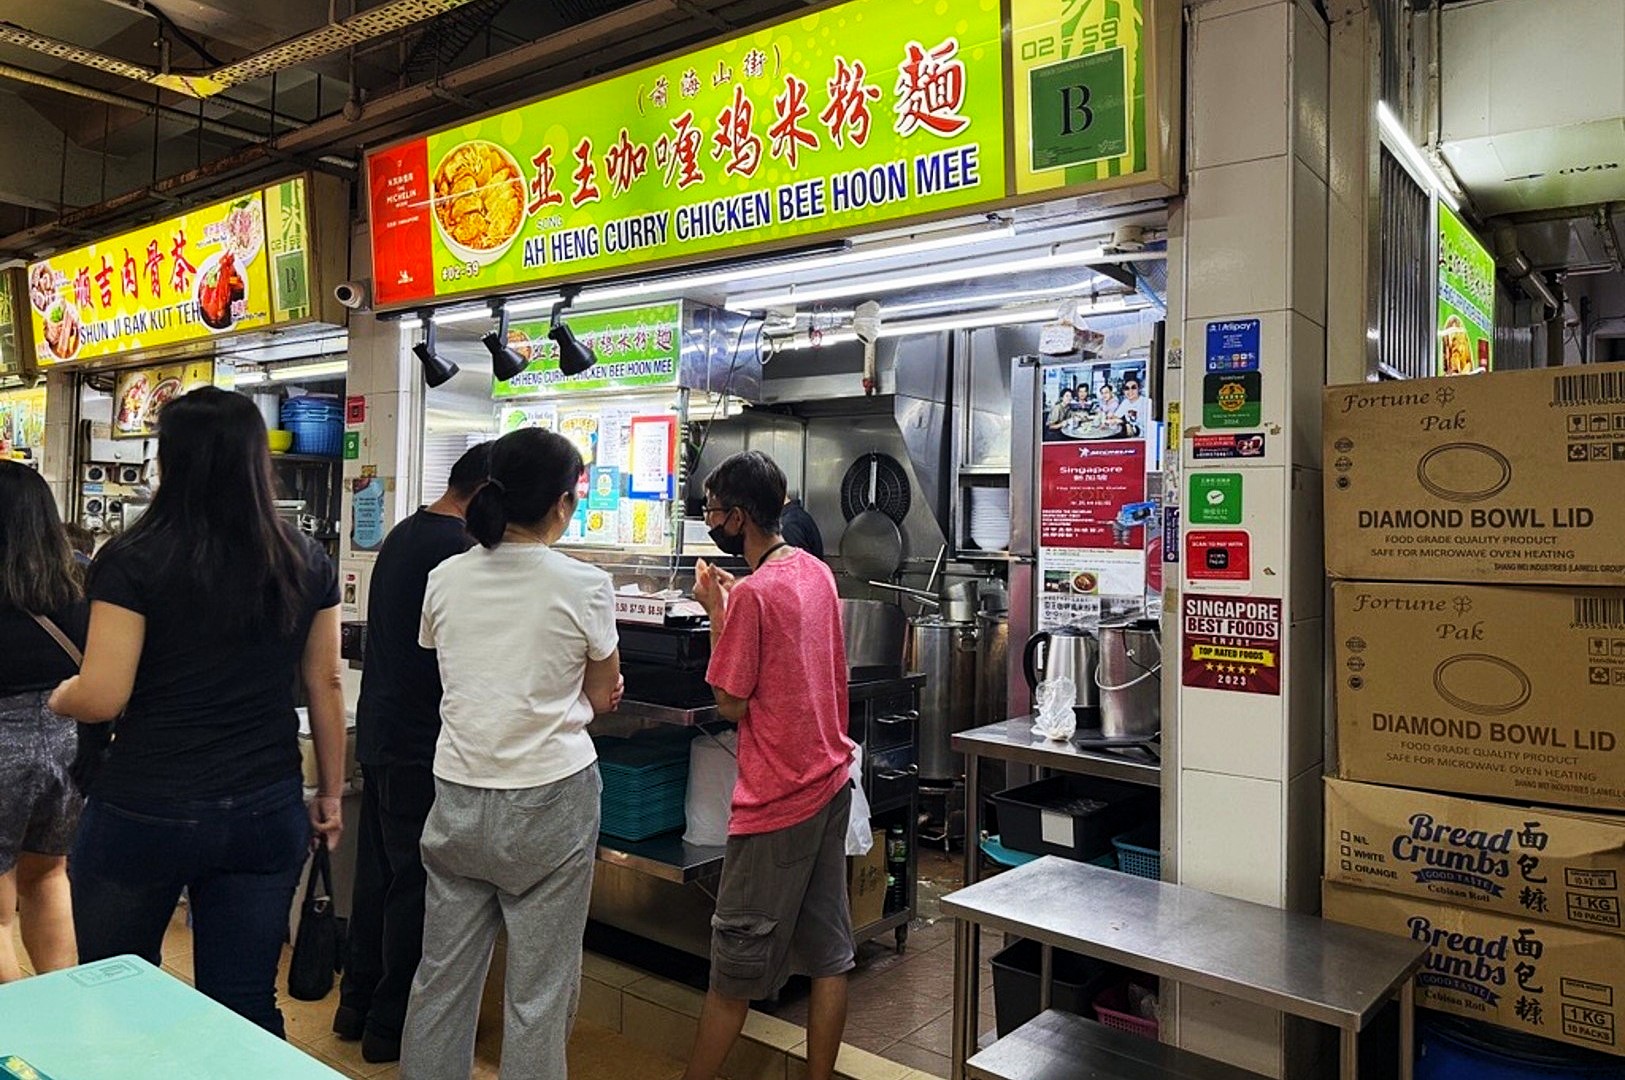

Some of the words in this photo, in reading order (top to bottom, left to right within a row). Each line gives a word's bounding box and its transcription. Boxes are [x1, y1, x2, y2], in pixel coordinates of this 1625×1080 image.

[1059, 84, 1094, 136] B
[523, 238, 545, 268] AH
[551, 226, 598, 262] HENG
[604, 211, 668, 252] CURRY
[676, 191, 769, 240] CHICKEN
[778, 180, 824, 221] BEE
[832, 162, 906, 211] HOON
[915, 146, 978, 195] MEE
[442, 261, 479, 281] #02-59
[80, 321, 109, 345] SHUN
[112, 319, 121, 340] JI
[124, 313, 148, 336] BAK
[150, 307, 173, 331] KUT
[176, 301, 201, 324] TEH
[521, 372, 543, 385] HENG
[609, 363, 625, 377] BEE
[627, 361, 650, 375] HOON
[653, 359, 672, 373] MEE
[1341, 392, 1430, 413] Fortune
[1420, 410, 1467, 431] Pak
[1060, 466, 1122, 474] Singapore
[1358, 510, 1463, 528] DIAMOND
[1471, 509, 1545, 528] BOWL
[1553, 508, 1594, 527] LID
[1385, 536, 1415, 544] FOOD
[1417, 536, 1451, 544] GRADE
[1454, 536, 1500, 545] QUALITY
[1503, 536, 1557, 545] PRODUCT
[1371, 549, 1393, 557] SAFE
[1397, 549, 1418, 557] FOR
[1419, 549, 1486, 558] MICROWAVE
[1489, 550, 1521, 558] OVEN
[1525, 550, 1575, 559] HEATING
[1186, 599, 1278, 620] SINGAPORE
[1353, 594, 1447, 612] Fortune
[1188, 617, 1223, 634] BEST
[1227, 620, 1275, 638] FOODS
[1436, 621, 1486, 641] Pak
[1211, 636, 1250, 647] ENJOY
[1199, 647, 1213, 656] TOP
[1214, 648, 1238, 659] RATED
[1239, 650, 1264, 660] FOODS
[1217, 674, 1247, 687] 2023
[1372, 713, 1482, 740] DIAMOND
[1490, 723, 1566, 748] BOWL
[1574, 730, 1616, 752] LID
[1401, 741, 1431, 751] FOOD
[1433, 743, 1470, 755] GRADE
[1473, 747, 1520, 760] QUALITY
[1523, 752, 1578, 765] PRODUCT
[1386, 753, 1411, 763] SAFE
[1413, 755, 1435, 765] FOR
[1438, 757, 1506, 773] MICROWAVE
[1509, 765, 1542, 776] OVEN
[1545, 769, 1597, 782] HEATING
[1408, 813, 1513, 854] Bread
[1354, 850, 1385, 862] WHITE
[1392, 835, 1510, 878] Crumbs
[1355, 865, 1398, 879] ORANGE
[1517, 821, 1549, 912] 面包糠
[1426, 871, 1454, 880] GOOD
[1458, 874, 1489, 890] TASTE
[1575, 896, 1582, 906] 1
[1588, 898, 1610, 911] KG
[1584, 912, 1616, 923] PACKS
[1407, 916, 1508, 961] Bread
[1512, 928, 1544, 1025] 面包糠
[1571, 1008, 1577, 1020] 1
[1583, 1010, 1605, 1025] KG
[1579, 1026, 1610, 1041] PACKS
